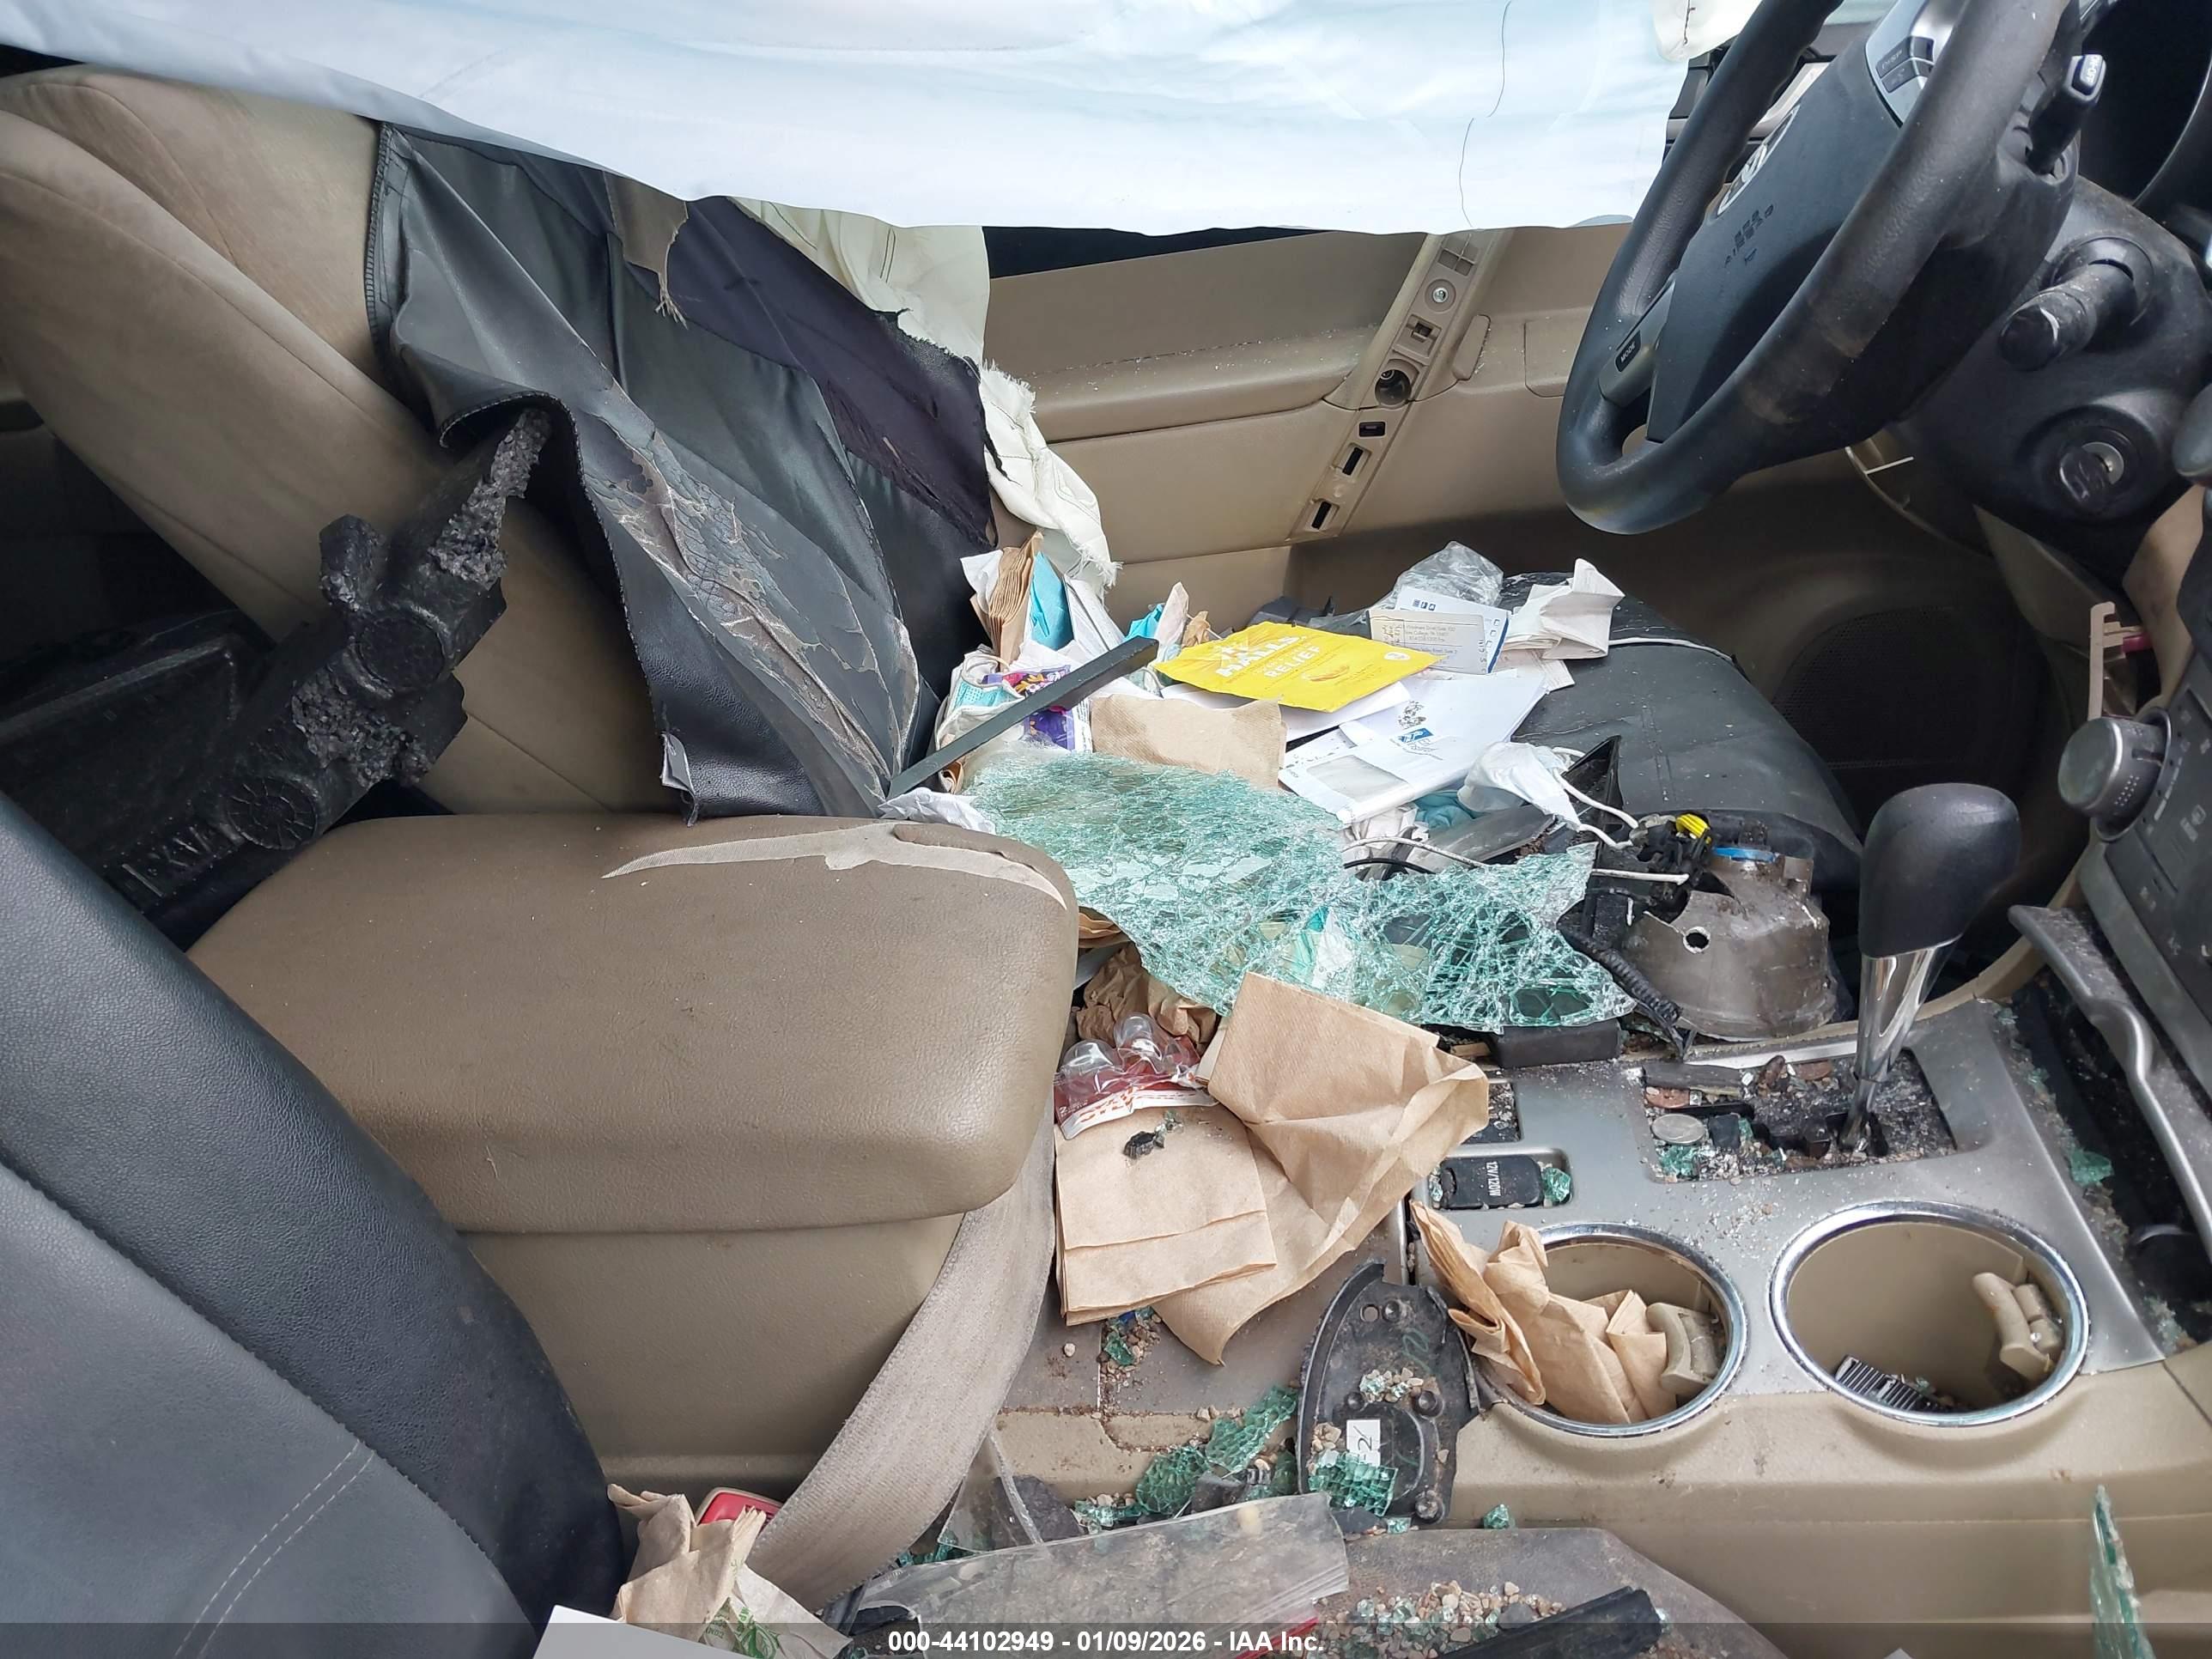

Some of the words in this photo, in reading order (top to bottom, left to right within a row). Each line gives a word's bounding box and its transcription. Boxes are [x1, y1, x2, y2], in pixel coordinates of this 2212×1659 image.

[1620, 340, 1636, 362] MODE
[1216, 636, 1300, 678] HALLS
[1263, 646, 1321, 678] RELIEF
[1486, 1161, 1501, 1196] 12V/120W
